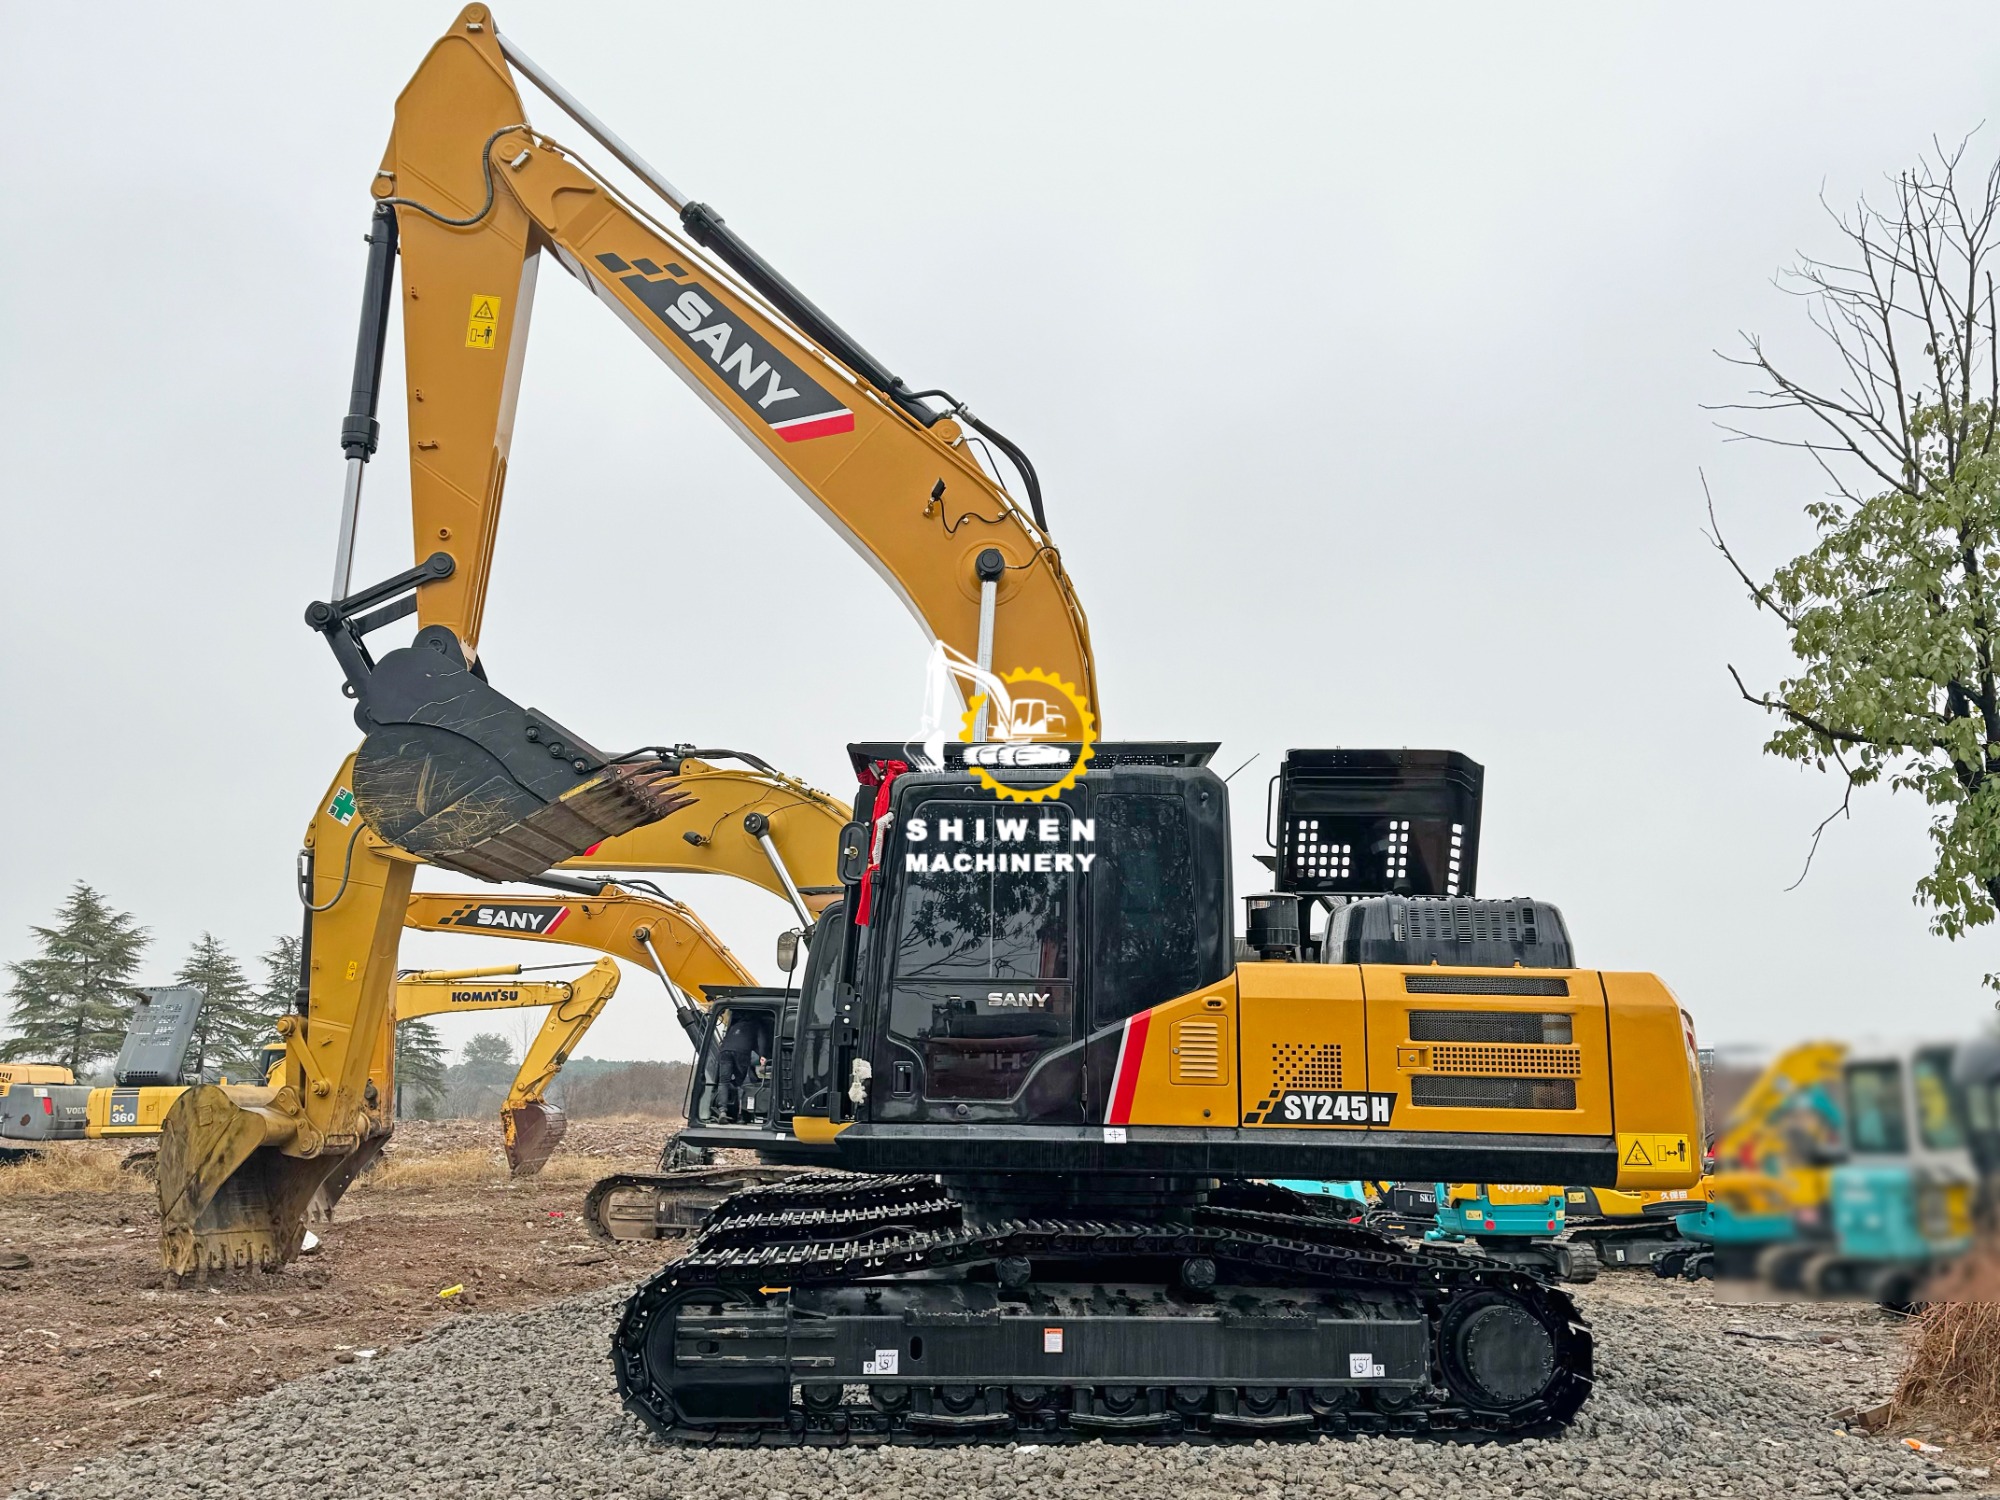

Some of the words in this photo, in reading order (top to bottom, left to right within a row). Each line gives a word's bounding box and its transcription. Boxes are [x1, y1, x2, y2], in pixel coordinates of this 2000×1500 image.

[665, 290, 801, 410] SANY
[476, 908, 545, 930] SANY
[451, 988, 519, 1003] KOMATSU
[987, 992, 1051, 1008] SANY
[65, 1107, 87, 1115] VOLV
[112, 1104, 125, 1112] PC
[1283, 1095, 1390, 1122] SY245H
[111, 1113, 135, 1123] 360
